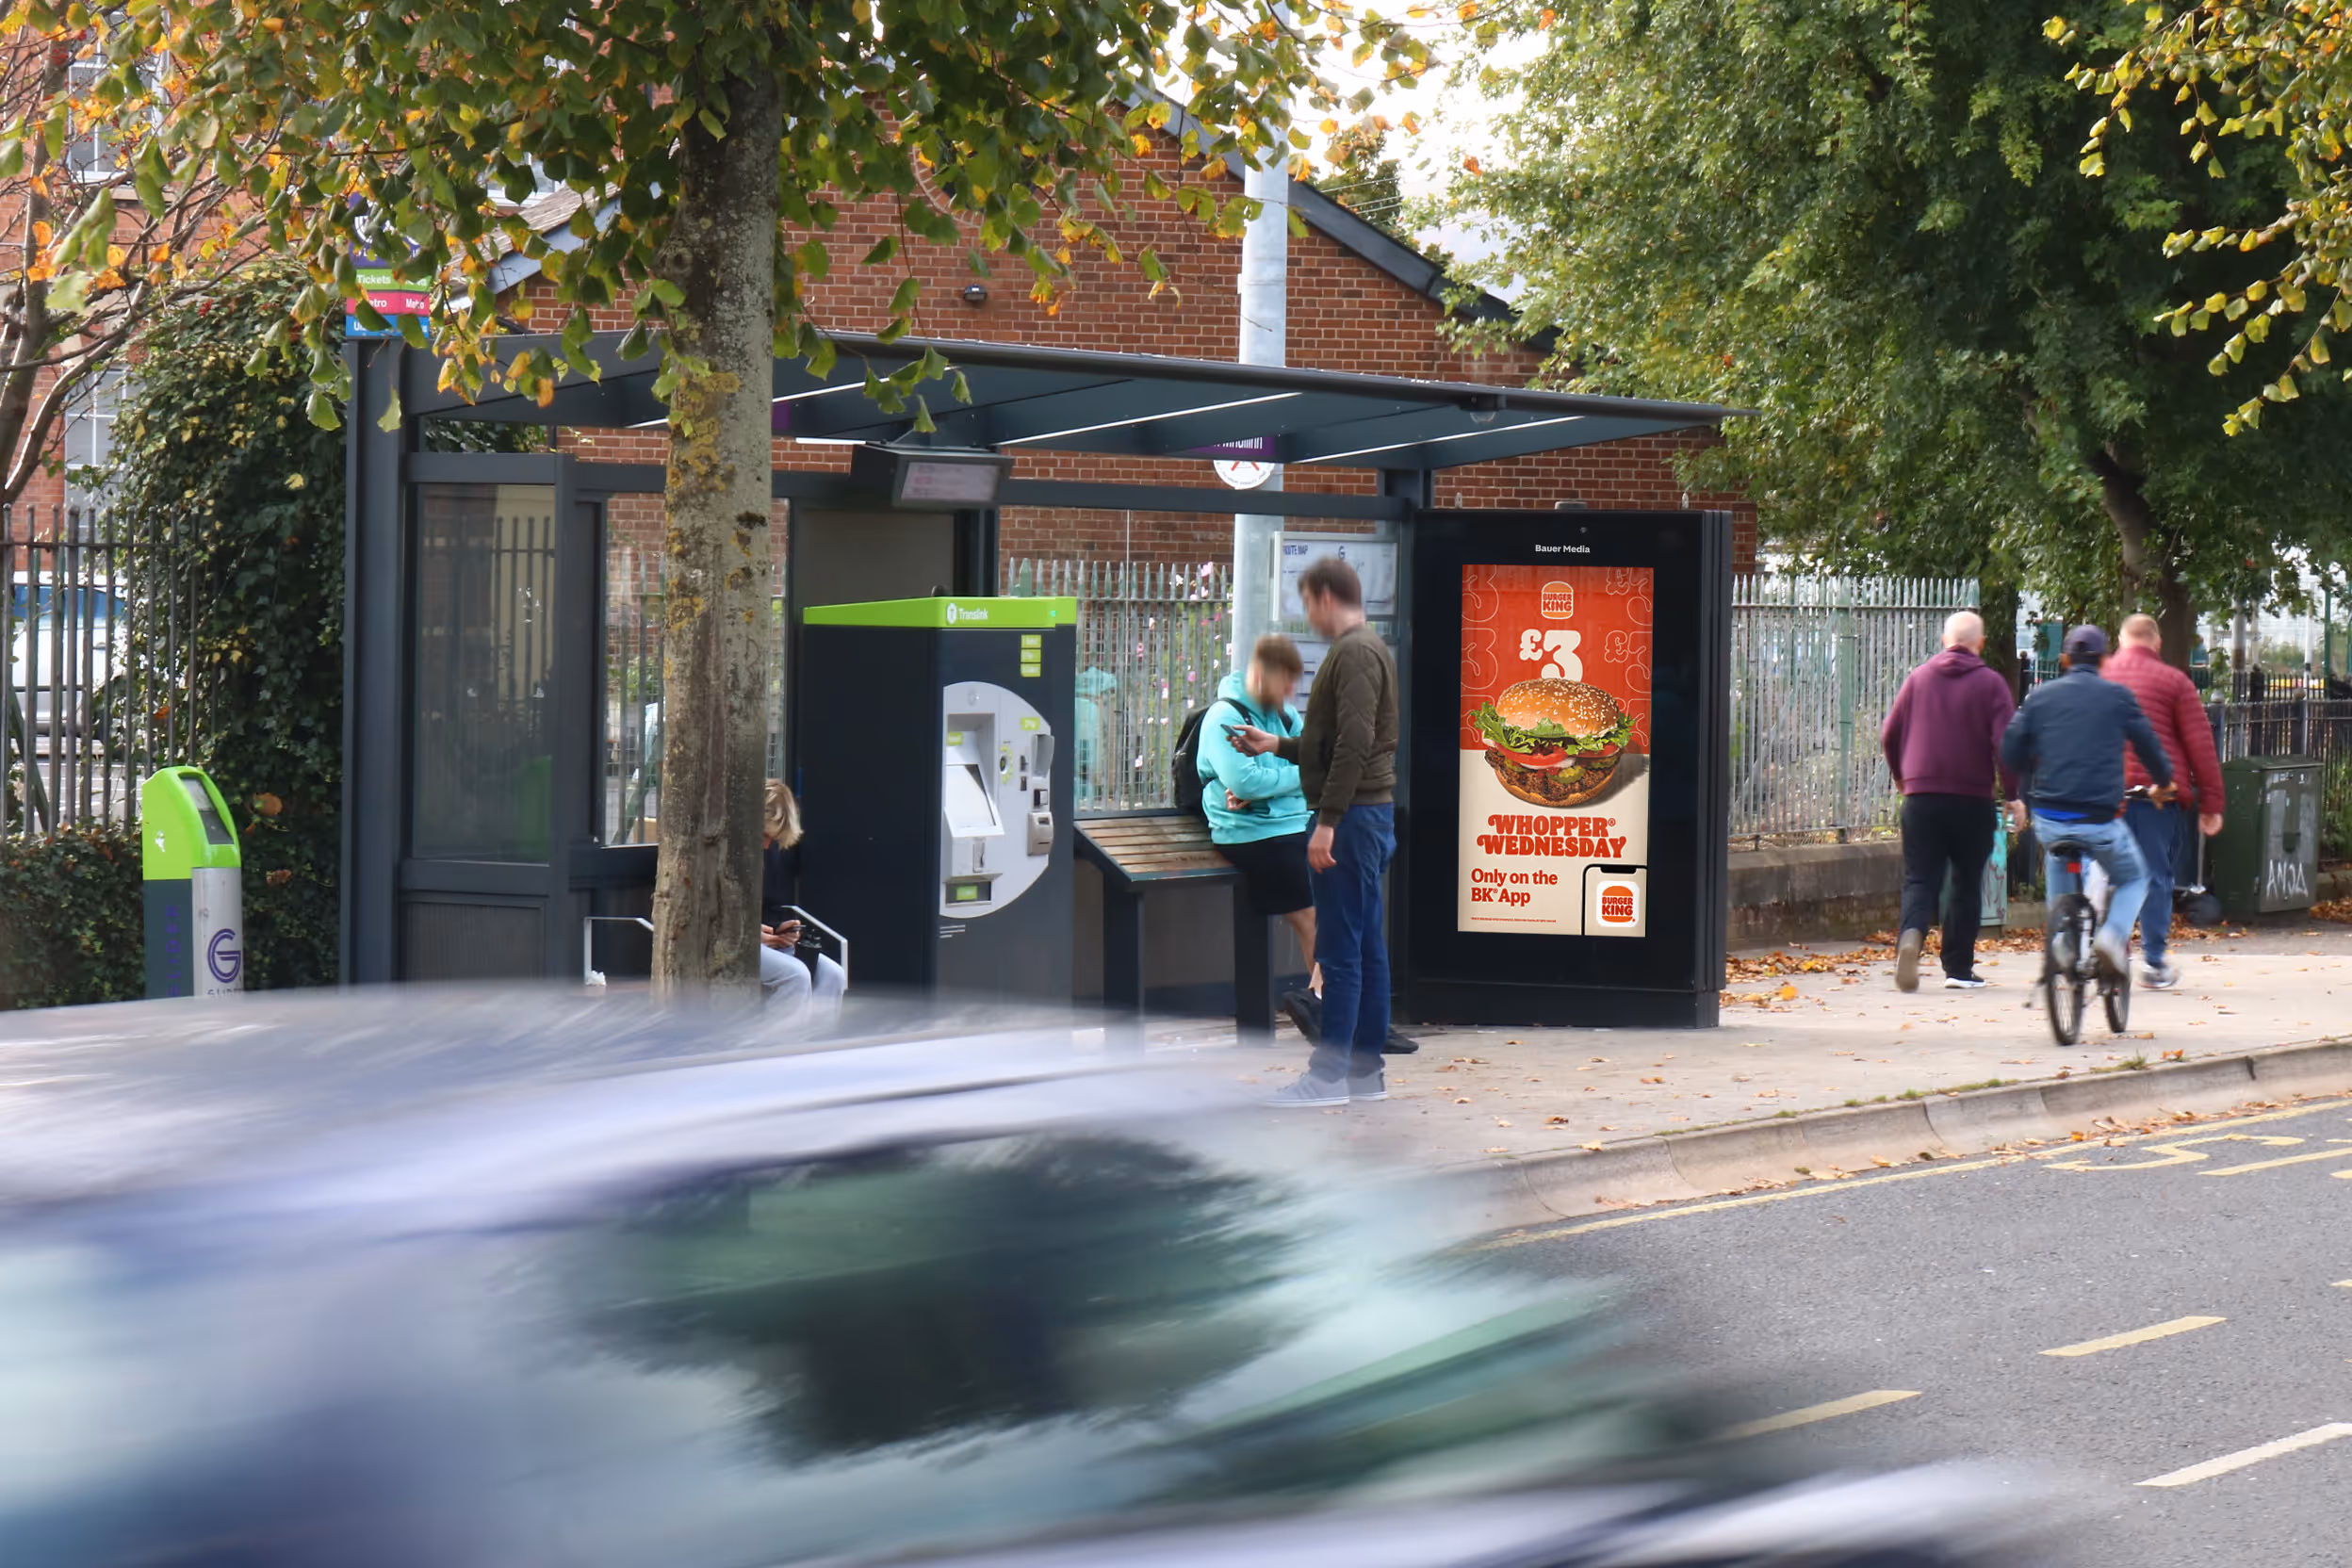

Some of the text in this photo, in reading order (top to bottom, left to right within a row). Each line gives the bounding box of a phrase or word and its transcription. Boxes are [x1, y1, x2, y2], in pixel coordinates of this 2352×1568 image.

[356, 274, 391, 285] Tickets
[368, 299, 387, 308] etro
[405, 299, 425, 309] Metro
[1535, 545, 1591, 553] Bauer Media
[1543, 593, 1573, 601] BURGER
[1543, 601, 1573, 612] KING
[959, 608, 988, 619] Translink
[1519, 629, 1583, 682] £3
[1477, 835, 1626, 858] WEDNESDAY
[1471, 868, 1558, 887] Only on the
[1498, 888, 1530, 906] App
[1602, 905, 1633, 916] KING
